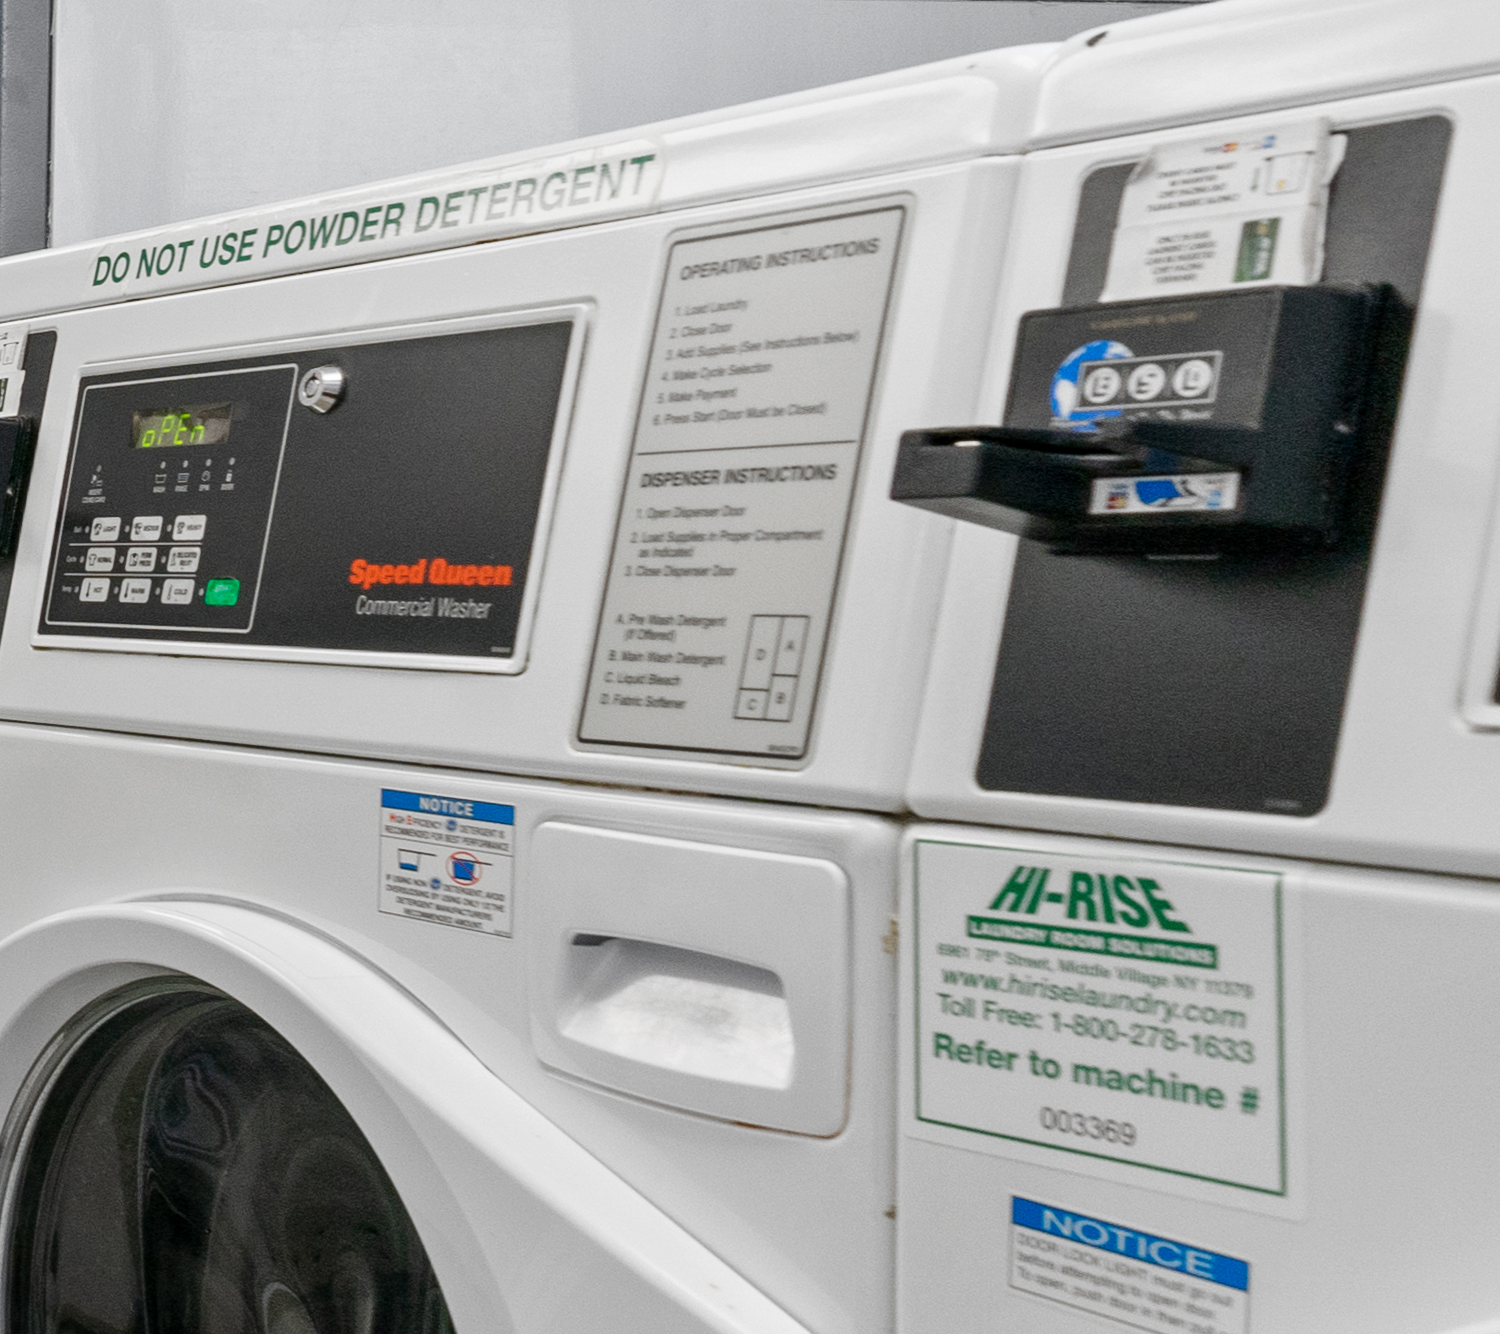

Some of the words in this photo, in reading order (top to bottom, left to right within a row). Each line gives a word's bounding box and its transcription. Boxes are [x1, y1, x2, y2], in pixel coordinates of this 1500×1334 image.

[92, 252, 130, 287] DO
[135, 239, 194, 280] NOT
[198, 228, 257, 269] USE
[262, 201, 406, 259] POWDER
[413, 154, 656, 234] DETERGENT
[679, 254, 764, 281] OPERATING
[764, 238, 881, 268] INSTRUCTIONS
[640, 468, 722, 488] DISPENSER
[724, 463, 838, 485] INSTRUCTIONS
[348, 558, 428, 590] Speed
[428, 557, 513, 586] Queen
[355, 594, 436, 617] Commercial
[437, 596, 492, 619] Washer
[419, 797, 474, 817] NOTICE
[988, 865, 1194, 934] HI-RISE
[941, 968, 1247, 1028] www.hiriselaundry.com
[936, 991, 977, 1018] Toll
[982, 999, 1043, 1029] Free:
[1052, 1011, 1256, 1064] 1-800-278-1633
[933, 1031, 1019, 1071] Refer
[1029, 1049, 1061, 1079] to
[1071, 1063, 1226, 1109] machine
[1239, 1085, 1260, 1115] #
[1039, 1105, 1138, 1147] 003369
[1042, 1208, 1215, 1280] NOTICE
